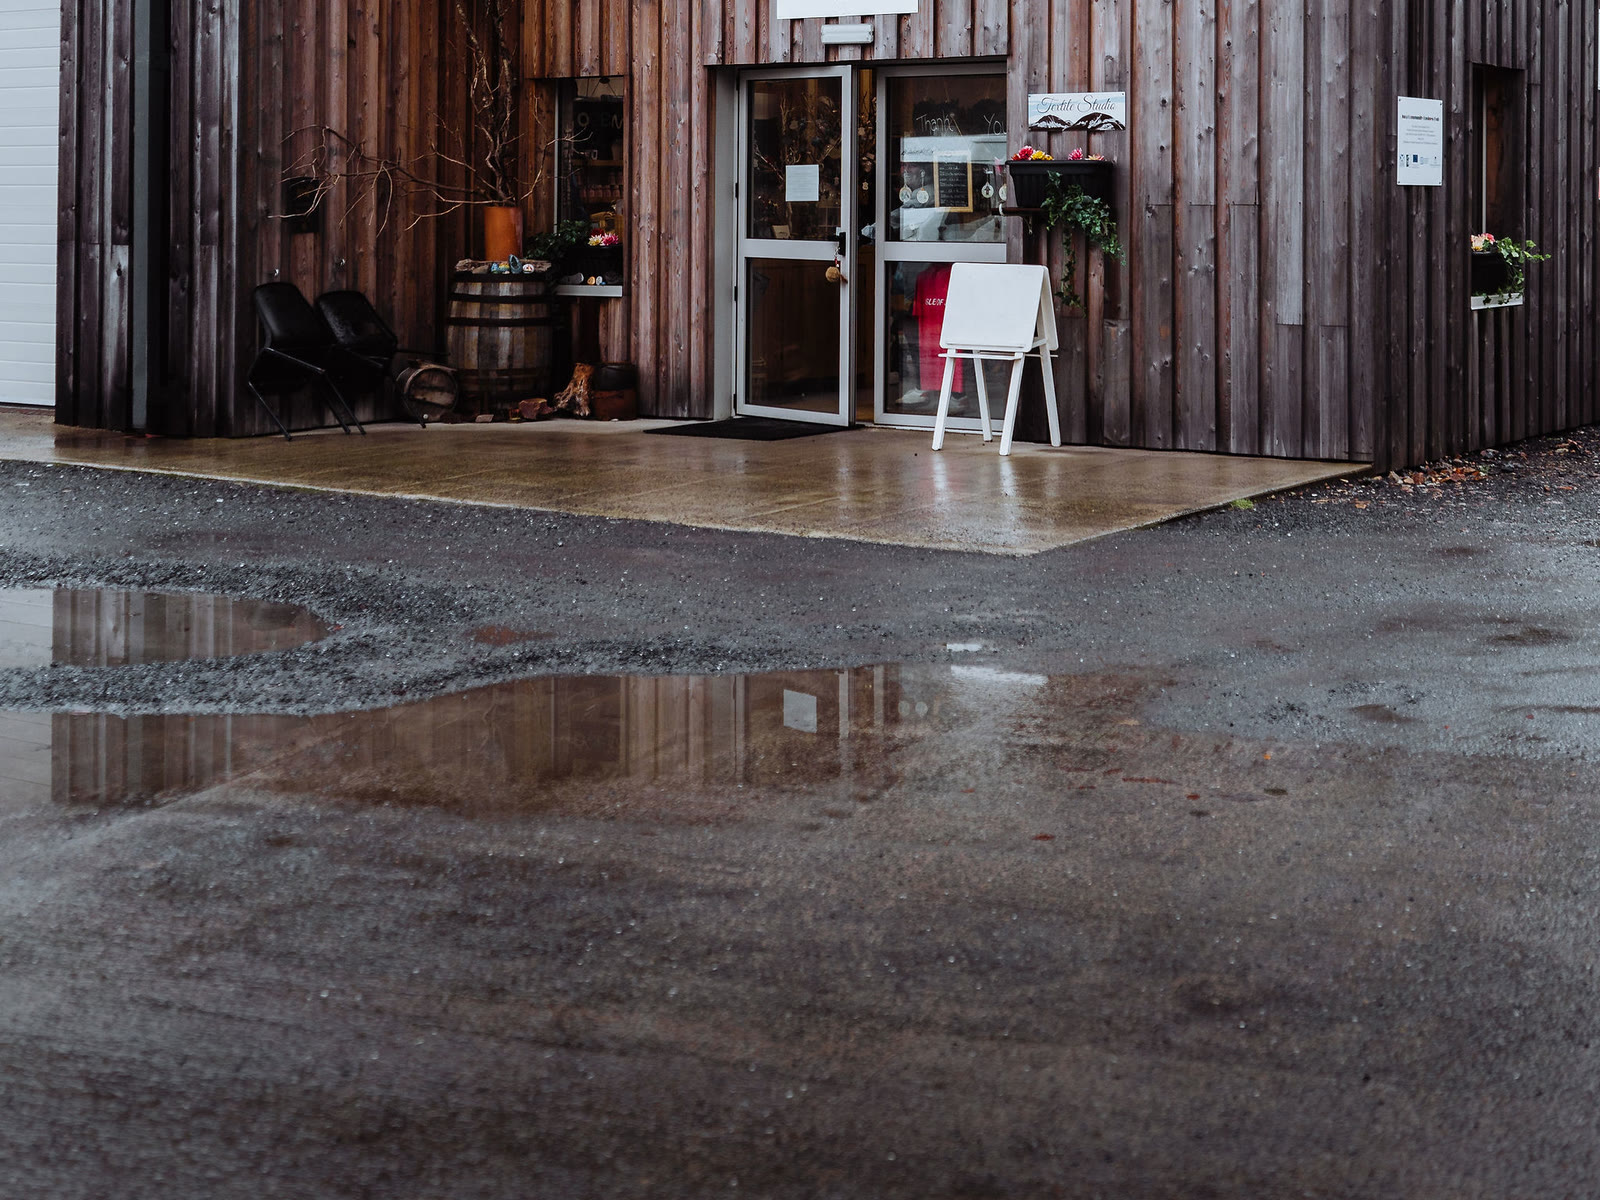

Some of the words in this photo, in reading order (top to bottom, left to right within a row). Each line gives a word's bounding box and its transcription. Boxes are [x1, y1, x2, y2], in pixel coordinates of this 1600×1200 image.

[1036, 97, 1073, 113] Textile
[1077, 95, 1115, 112] Studio
[577, 111, 624, 130] OEN
